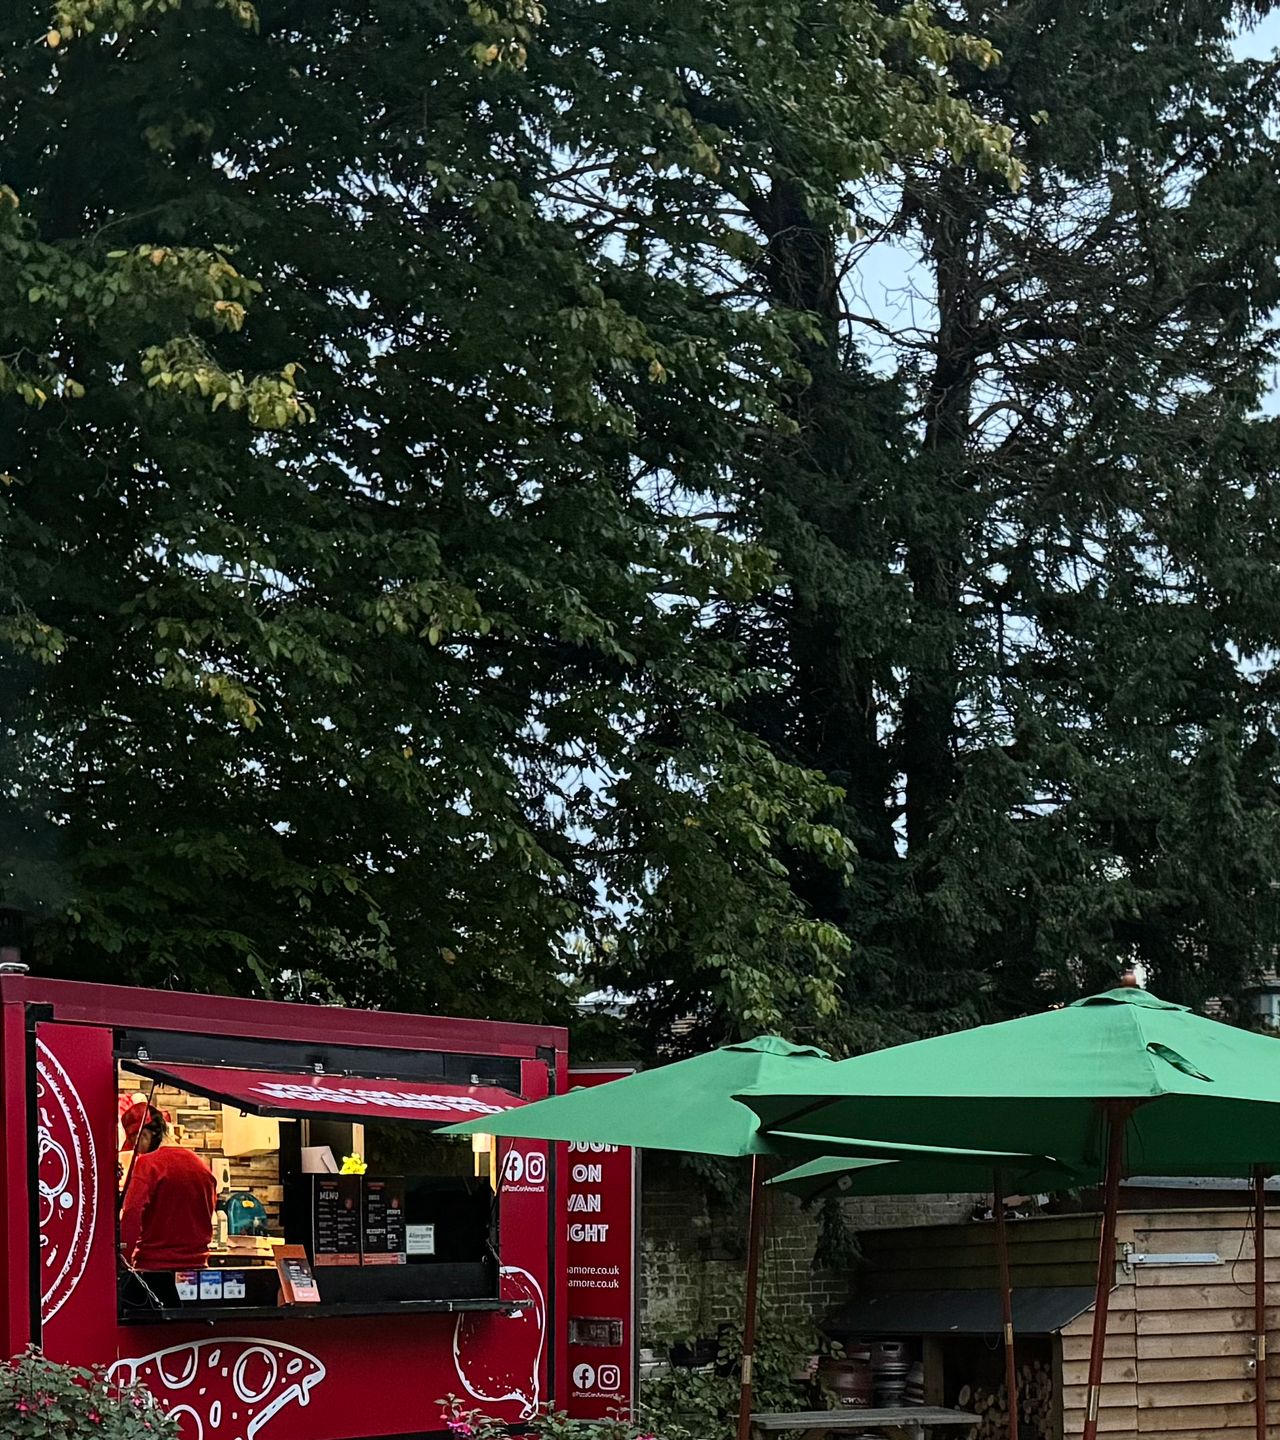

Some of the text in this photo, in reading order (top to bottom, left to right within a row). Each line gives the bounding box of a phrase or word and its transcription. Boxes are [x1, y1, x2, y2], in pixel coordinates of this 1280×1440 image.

[442, 1102, 514, 1114] PIZZ
[572, 1163, 602, 1183] ON
[567, 1194, 601, 1212] VAN
[567, 1265, 620, 1275] amore.co.uk
